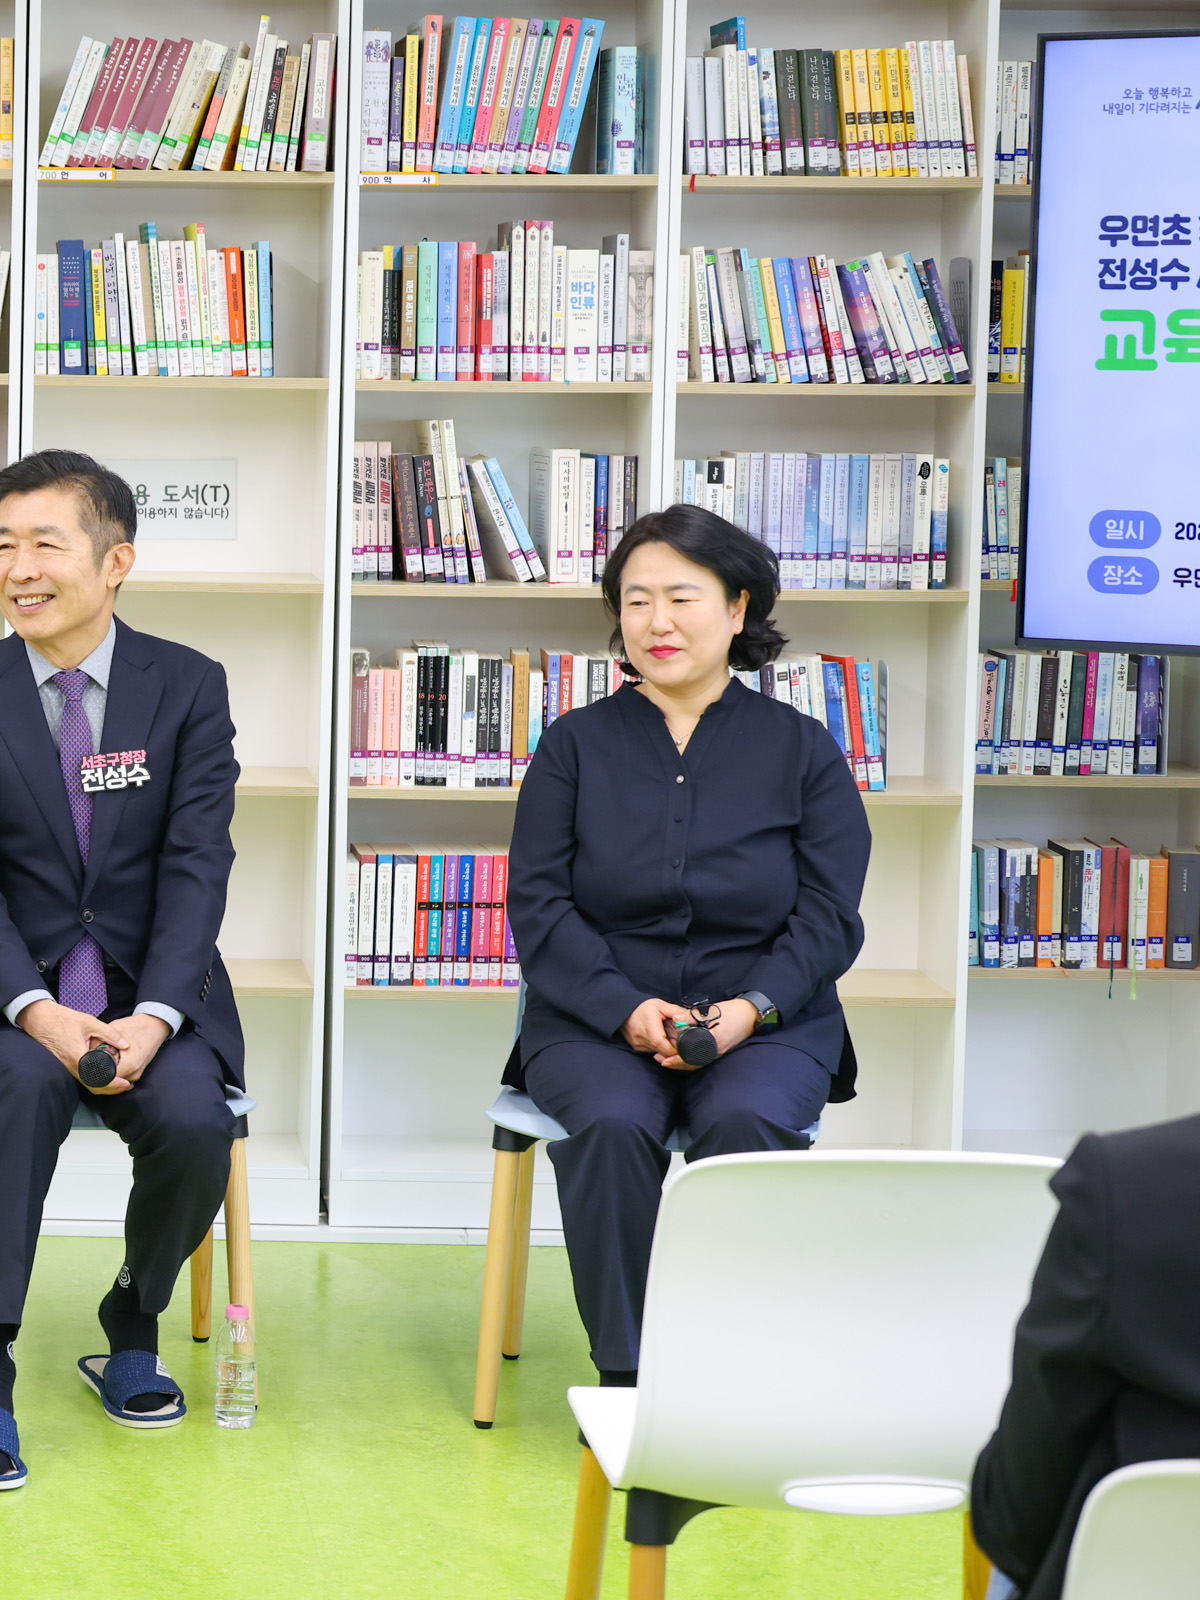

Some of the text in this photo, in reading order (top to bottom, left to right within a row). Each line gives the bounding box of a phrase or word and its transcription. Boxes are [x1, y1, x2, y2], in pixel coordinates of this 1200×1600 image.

[427, 63, 435, 85] 용선생
[454, 64, 463, 85] 용선생
[470, 65, 480, 86] 용선생
[487, 65, 497, 86] 용선생
[504, 66, 514, 87] 용선생
[520, 66, 530, 87] 용선생
[535, 66, 545, 87] 용선생
[553, 66, 565, 87] 용선생
[575, 66, 587, 87] 용선생
[785, 55, 797, 100] 나는 걷는다
[810, 55, 821, 100] 나는 걷는다
[821, 57, 833, 102] 나는 걷는다
[844, 70, 851, 82] 제주
[873, 69, 881, 91] 캐나다
[313, 79, 326, 118] 고사성어
[425, 85, 434, 105] 세계사
[451, 85, 460, 106] 세계사
[467, 86, 477, 106] 세계사
[483, 86, 493, 107] 세계사
[500, 86, 511, 107] 세계사
[515, 87, 526, 107] 세계사
[529, 86, 541, 107] 세계사
[548, 86, 560, 107] 세계사
[570, 86, 582, 107] 세계사
[1122, 85, 1192, 100] 오늘 행복하고
[1102, 101, 1192, 115] 내일이 기다려지는
[40, 171, 57, 180] 700
[362, 176, 380, 185] 900
[1098, 213, 1191, 248] 우면초
[498, 257, 508, 295] 휴먼카인드
[1098, 257, 1190, 291] 전성수
[405, 279, 414, 295] 10년
[570, 281, 596, 296] 바다
[404, 302, 414, 323] 세계사
[570, 296, 596, 310] 인류
[432, 432, 443, 462] 사피엔스
[445, 432, 456, 462] 사피엔스
[380, 457, 391, 505] 벌거벗은 세계사
[421, 459, 433, 504] 호모 데우스
[133, 483, 230, 506] 용 도서(T)
[353, 480, 363, 505] 세계사
[365, 480, 375, 505] 세계사
[137, 507, 230, 519] 이용하지 않습니다)
[1105, 519, 1145, 541] 일시
[1174, 521, 1200, 541] 20
[1103, 565, 1144, 586] 장소
[1172, 567, 1200, 588] 우
[438, 692, 448, 702] 20
[1043, 664, 1053, 713] Hillbilly Elegy
[405, 668, 415, 732] 고려사의 재발견
[80, 749, 147, 769] 서초구청장
[80, 763, 151, 793] 전성수
